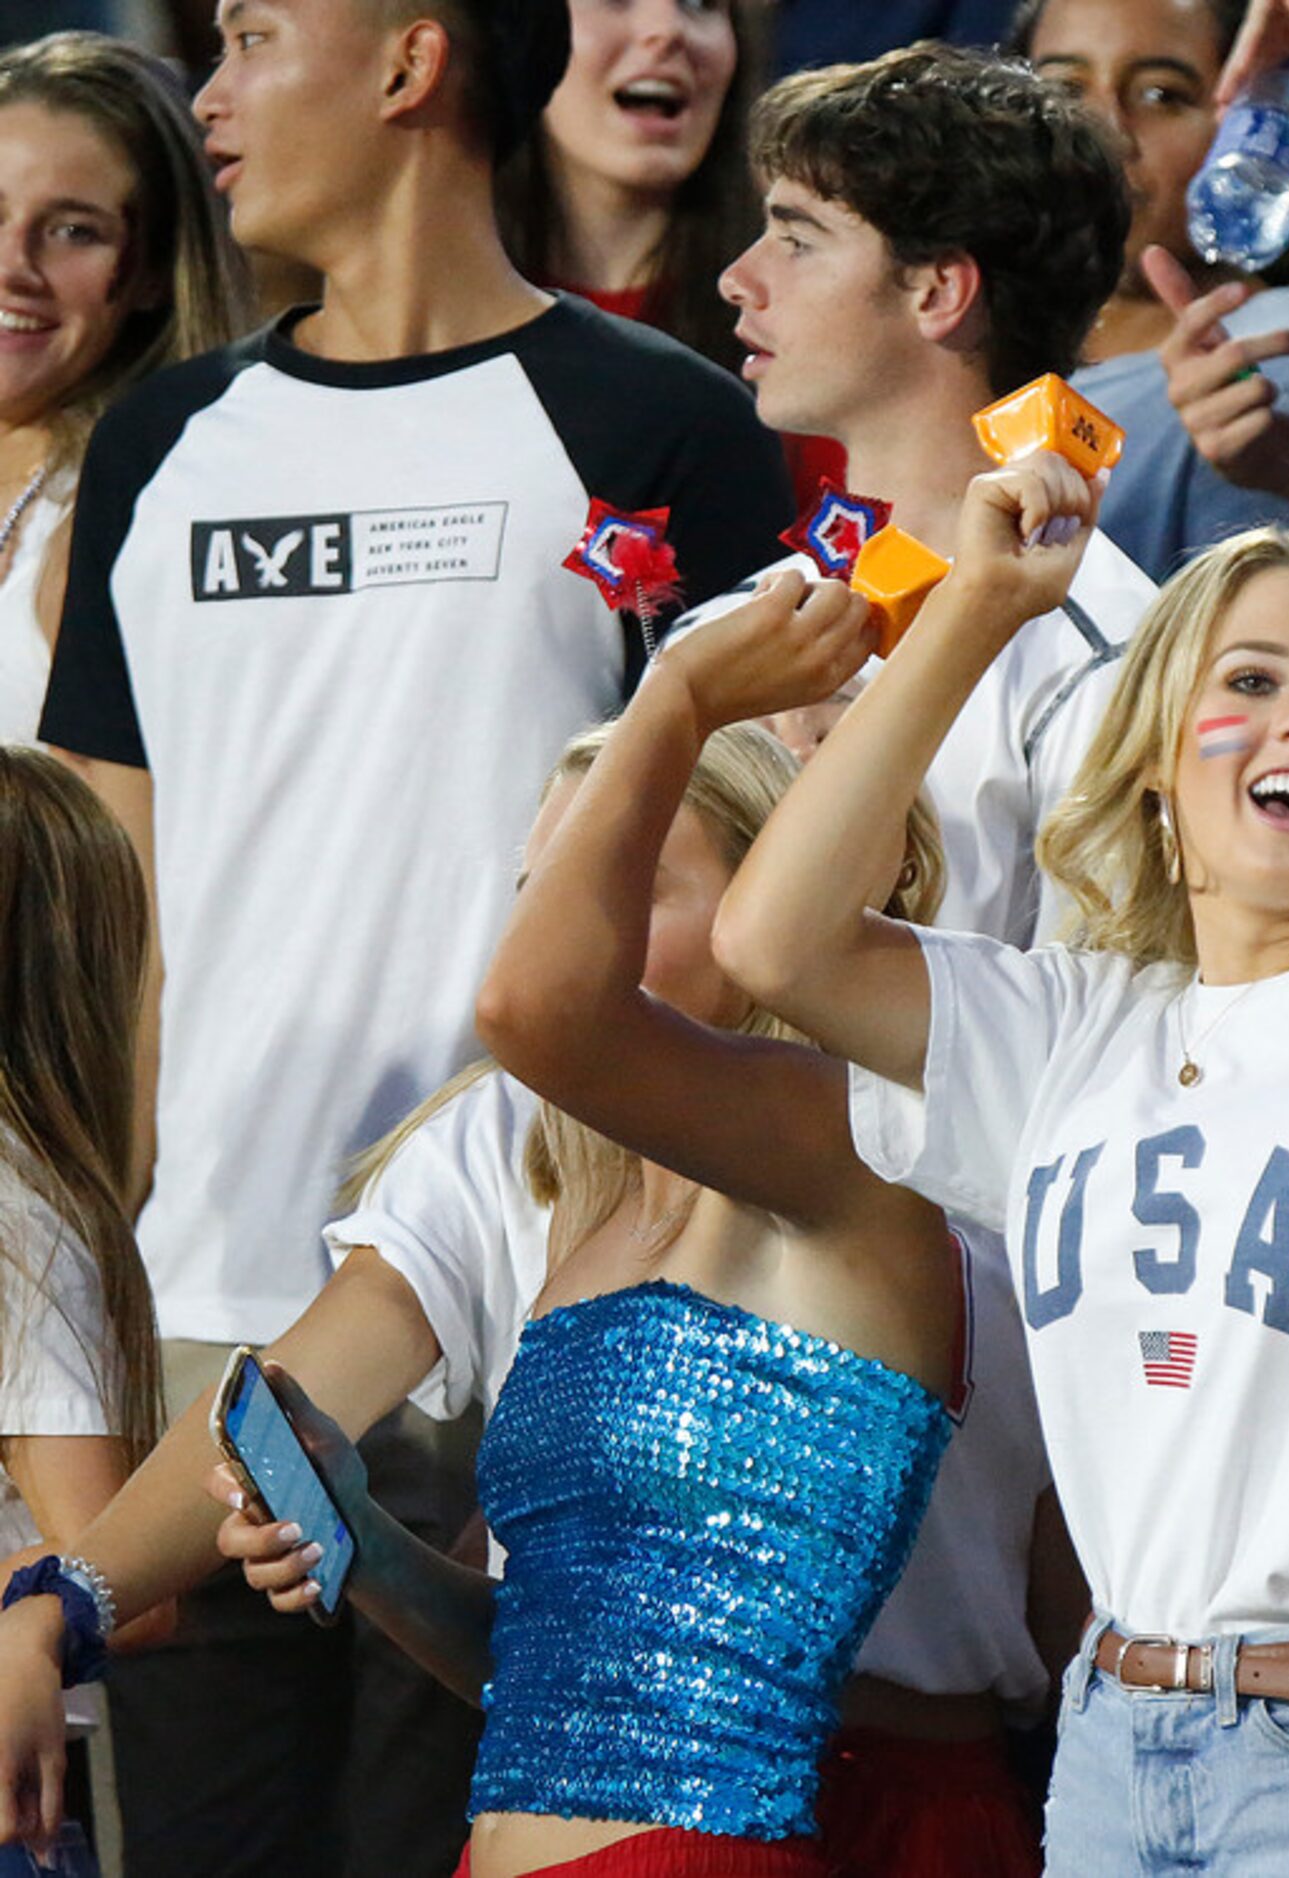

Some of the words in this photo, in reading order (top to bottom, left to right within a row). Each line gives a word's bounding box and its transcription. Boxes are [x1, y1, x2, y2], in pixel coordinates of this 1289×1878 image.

[369, 519, 436, 533] AMERICAN
[442, 513, 484, 527] EAGLE
[368, 545, 392, 559] NEW
[400, 540, 430, 555] YORK
[437, 536, 467, 553] CITY
[425, 558, 467, 572] SEVEN
